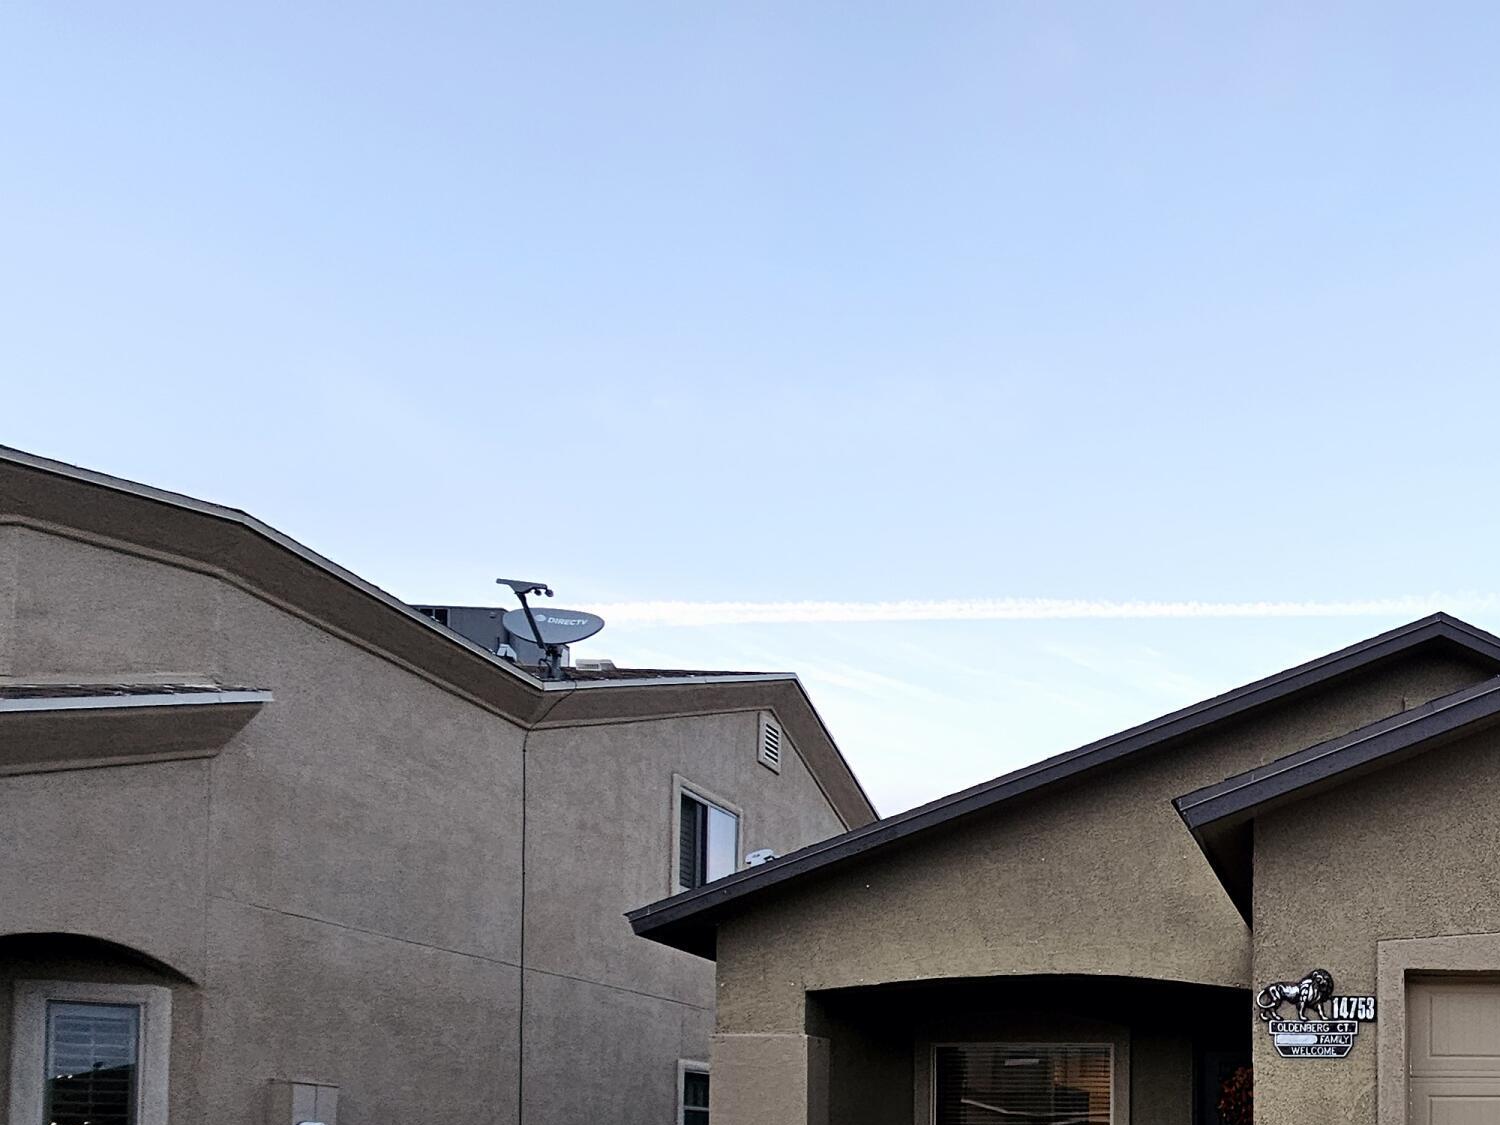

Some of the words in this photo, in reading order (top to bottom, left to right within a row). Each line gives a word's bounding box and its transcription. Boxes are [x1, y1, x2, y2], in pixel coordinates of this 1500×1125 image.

[548, 617, 587, 625] DIRECTV
[1333, 997, 1375, 1019] 14753
[1277, 1023, 1330, 1032] OLDENBERG
[1320, 1035, 1349, 1044] FAMILY
[1291, 1046, 1337, 1055] WELCOME
